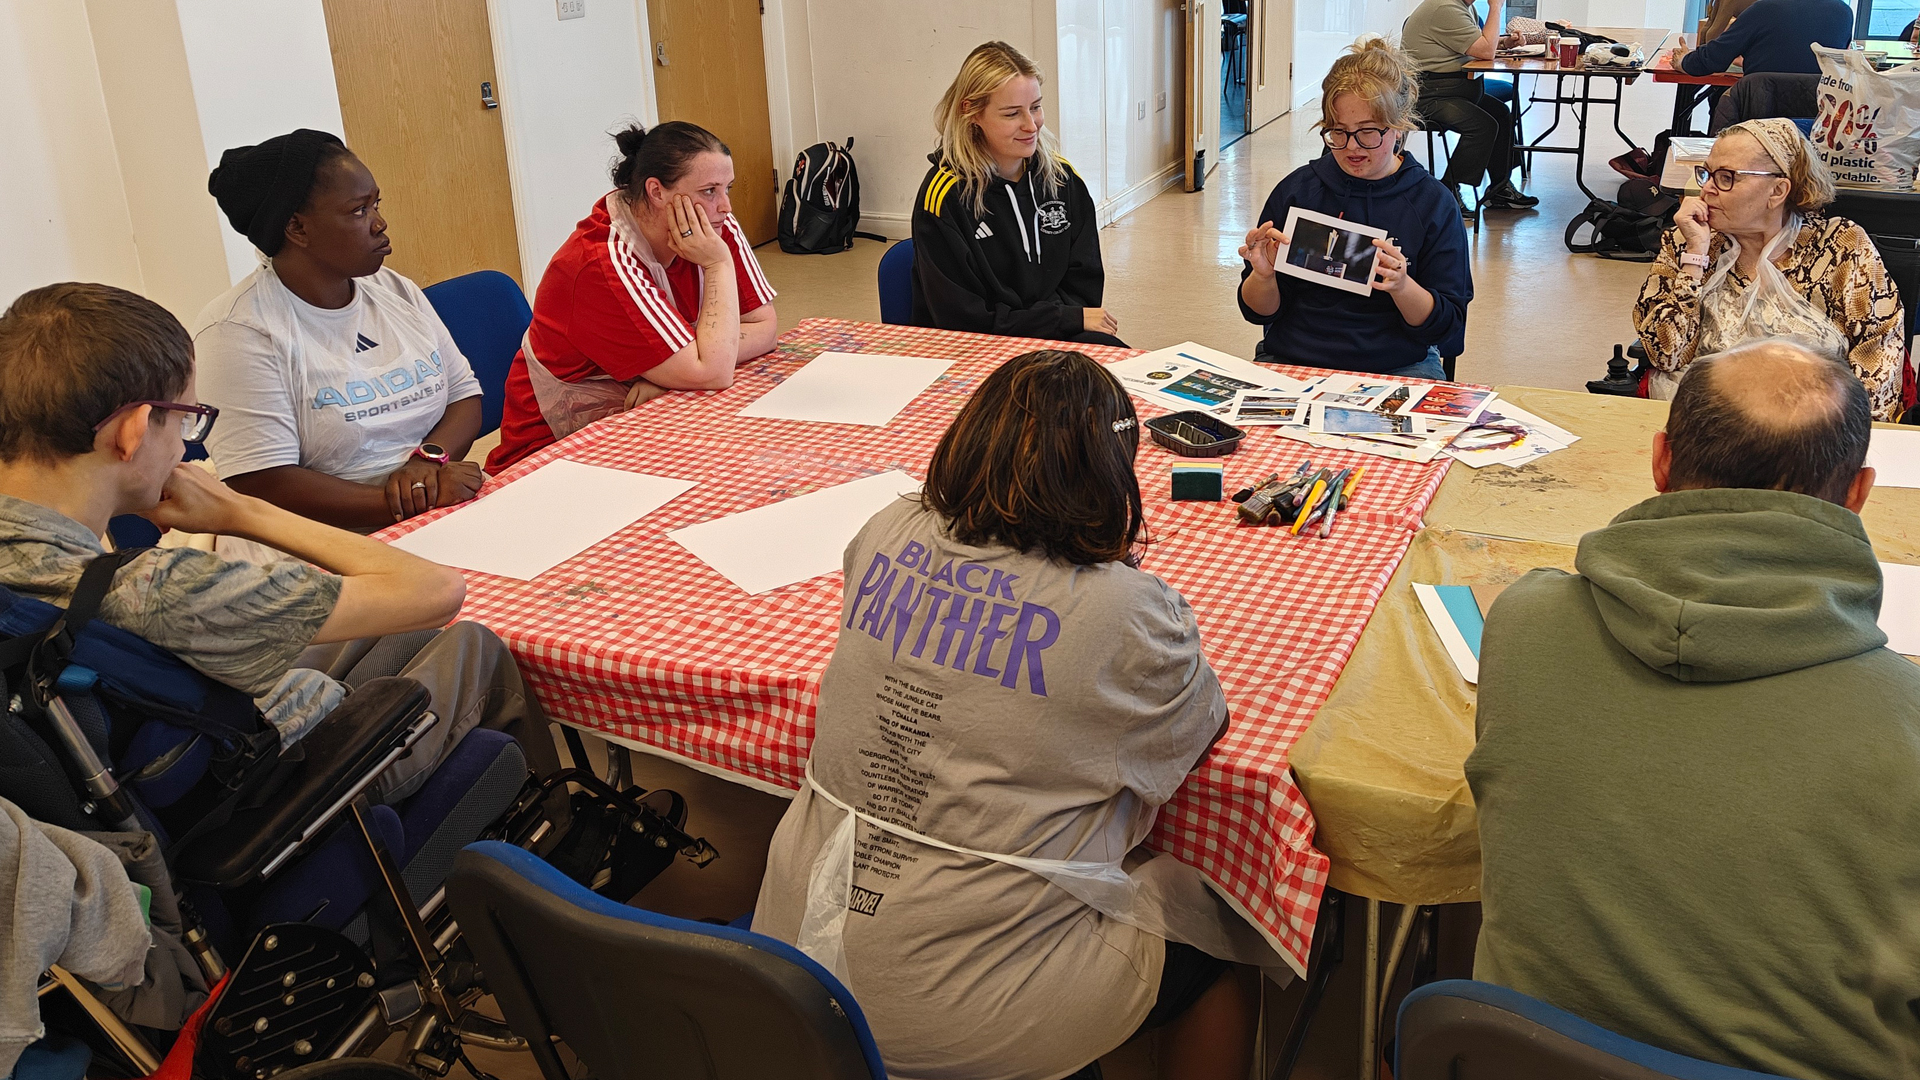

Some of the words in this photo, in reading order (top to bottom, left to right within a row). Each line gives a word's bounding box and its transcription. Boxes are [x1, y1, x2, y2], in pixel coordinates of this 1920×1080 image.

[1830, 156, 1875, 168] plastic
[1831, 171, 1881, 183] cyclable.
[896, 540, 1020, 602] BLACK
[846, 552, 1061, 698] PANTHER
[884, 675, 898, 684] WITH
[898, 680, 909, 690] THE
[910, 685, 943, 700] SLEEKNESS
[876, 692, 894, 705] WHOSE
[894, 701, 911, 712] NAME
[911, 707, 918, 715] HE
[892, 688, 902, 698] THE
[904, 692, 924, 706] JUNGLE
[926, 702, 938, 710] CAT
[900, 725, 930, 738] WAKANDA
[897, 733, 912, 744] BOTH
[914, 739, 926, 748] THE
[906, 747, 922, 756] CITY
[860, 770, 896, 784] COUNTLESS
[888, 766, 900, 775] HAS
[912, 778, 924, 786] FOR
[907, 766, 918, 776] THE
[866, 801, 877, 810] AND
[896, 808, 911, 820] SHALL
[855, 806, 866, 814] FOR
[866, 810, 878, 818] THE
[891, 817, 914, 832] DICTATES
[856, 840, 868, 850] THE
[868, 833, 881, 842] THE
